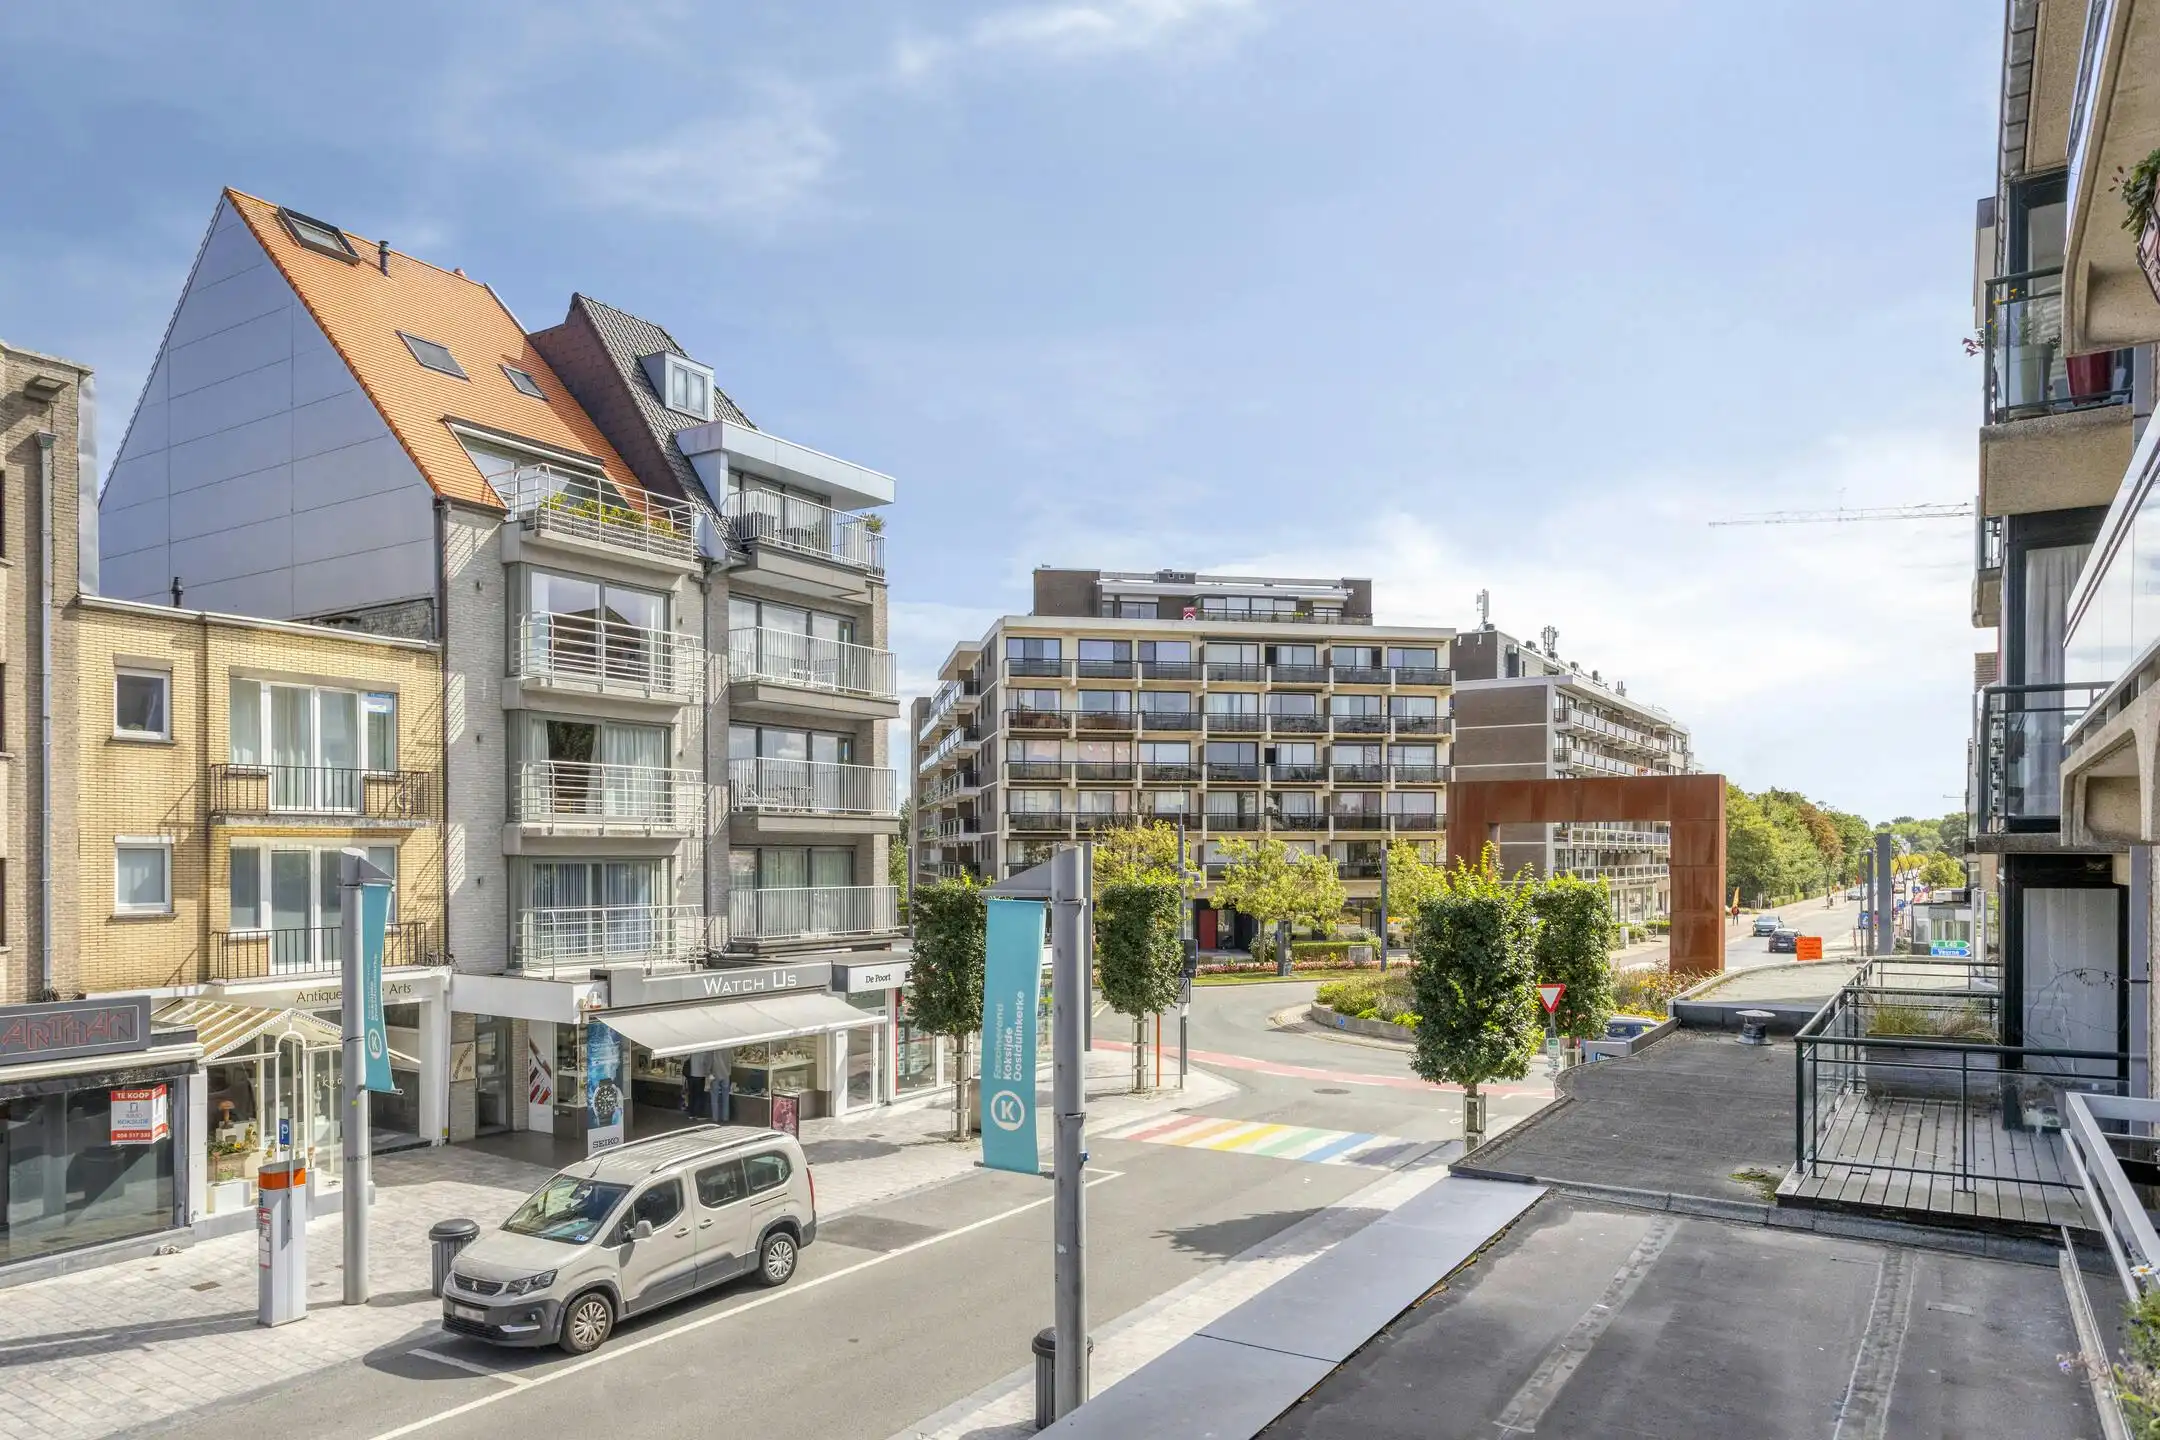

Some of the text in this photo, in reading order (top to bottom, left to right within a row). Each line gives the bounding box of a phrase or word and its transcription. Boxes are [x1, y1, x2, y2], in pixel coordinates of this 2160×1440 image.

[865, 973, 891, 983] De Poort
[389, 983, 412, 995] Arts
[1013, 990, 1025, 1081] Oostduinkerke
[1003, 1027, 1014, 1080] Koksijde
[592, 1137, 620, 1149] SEIKO
